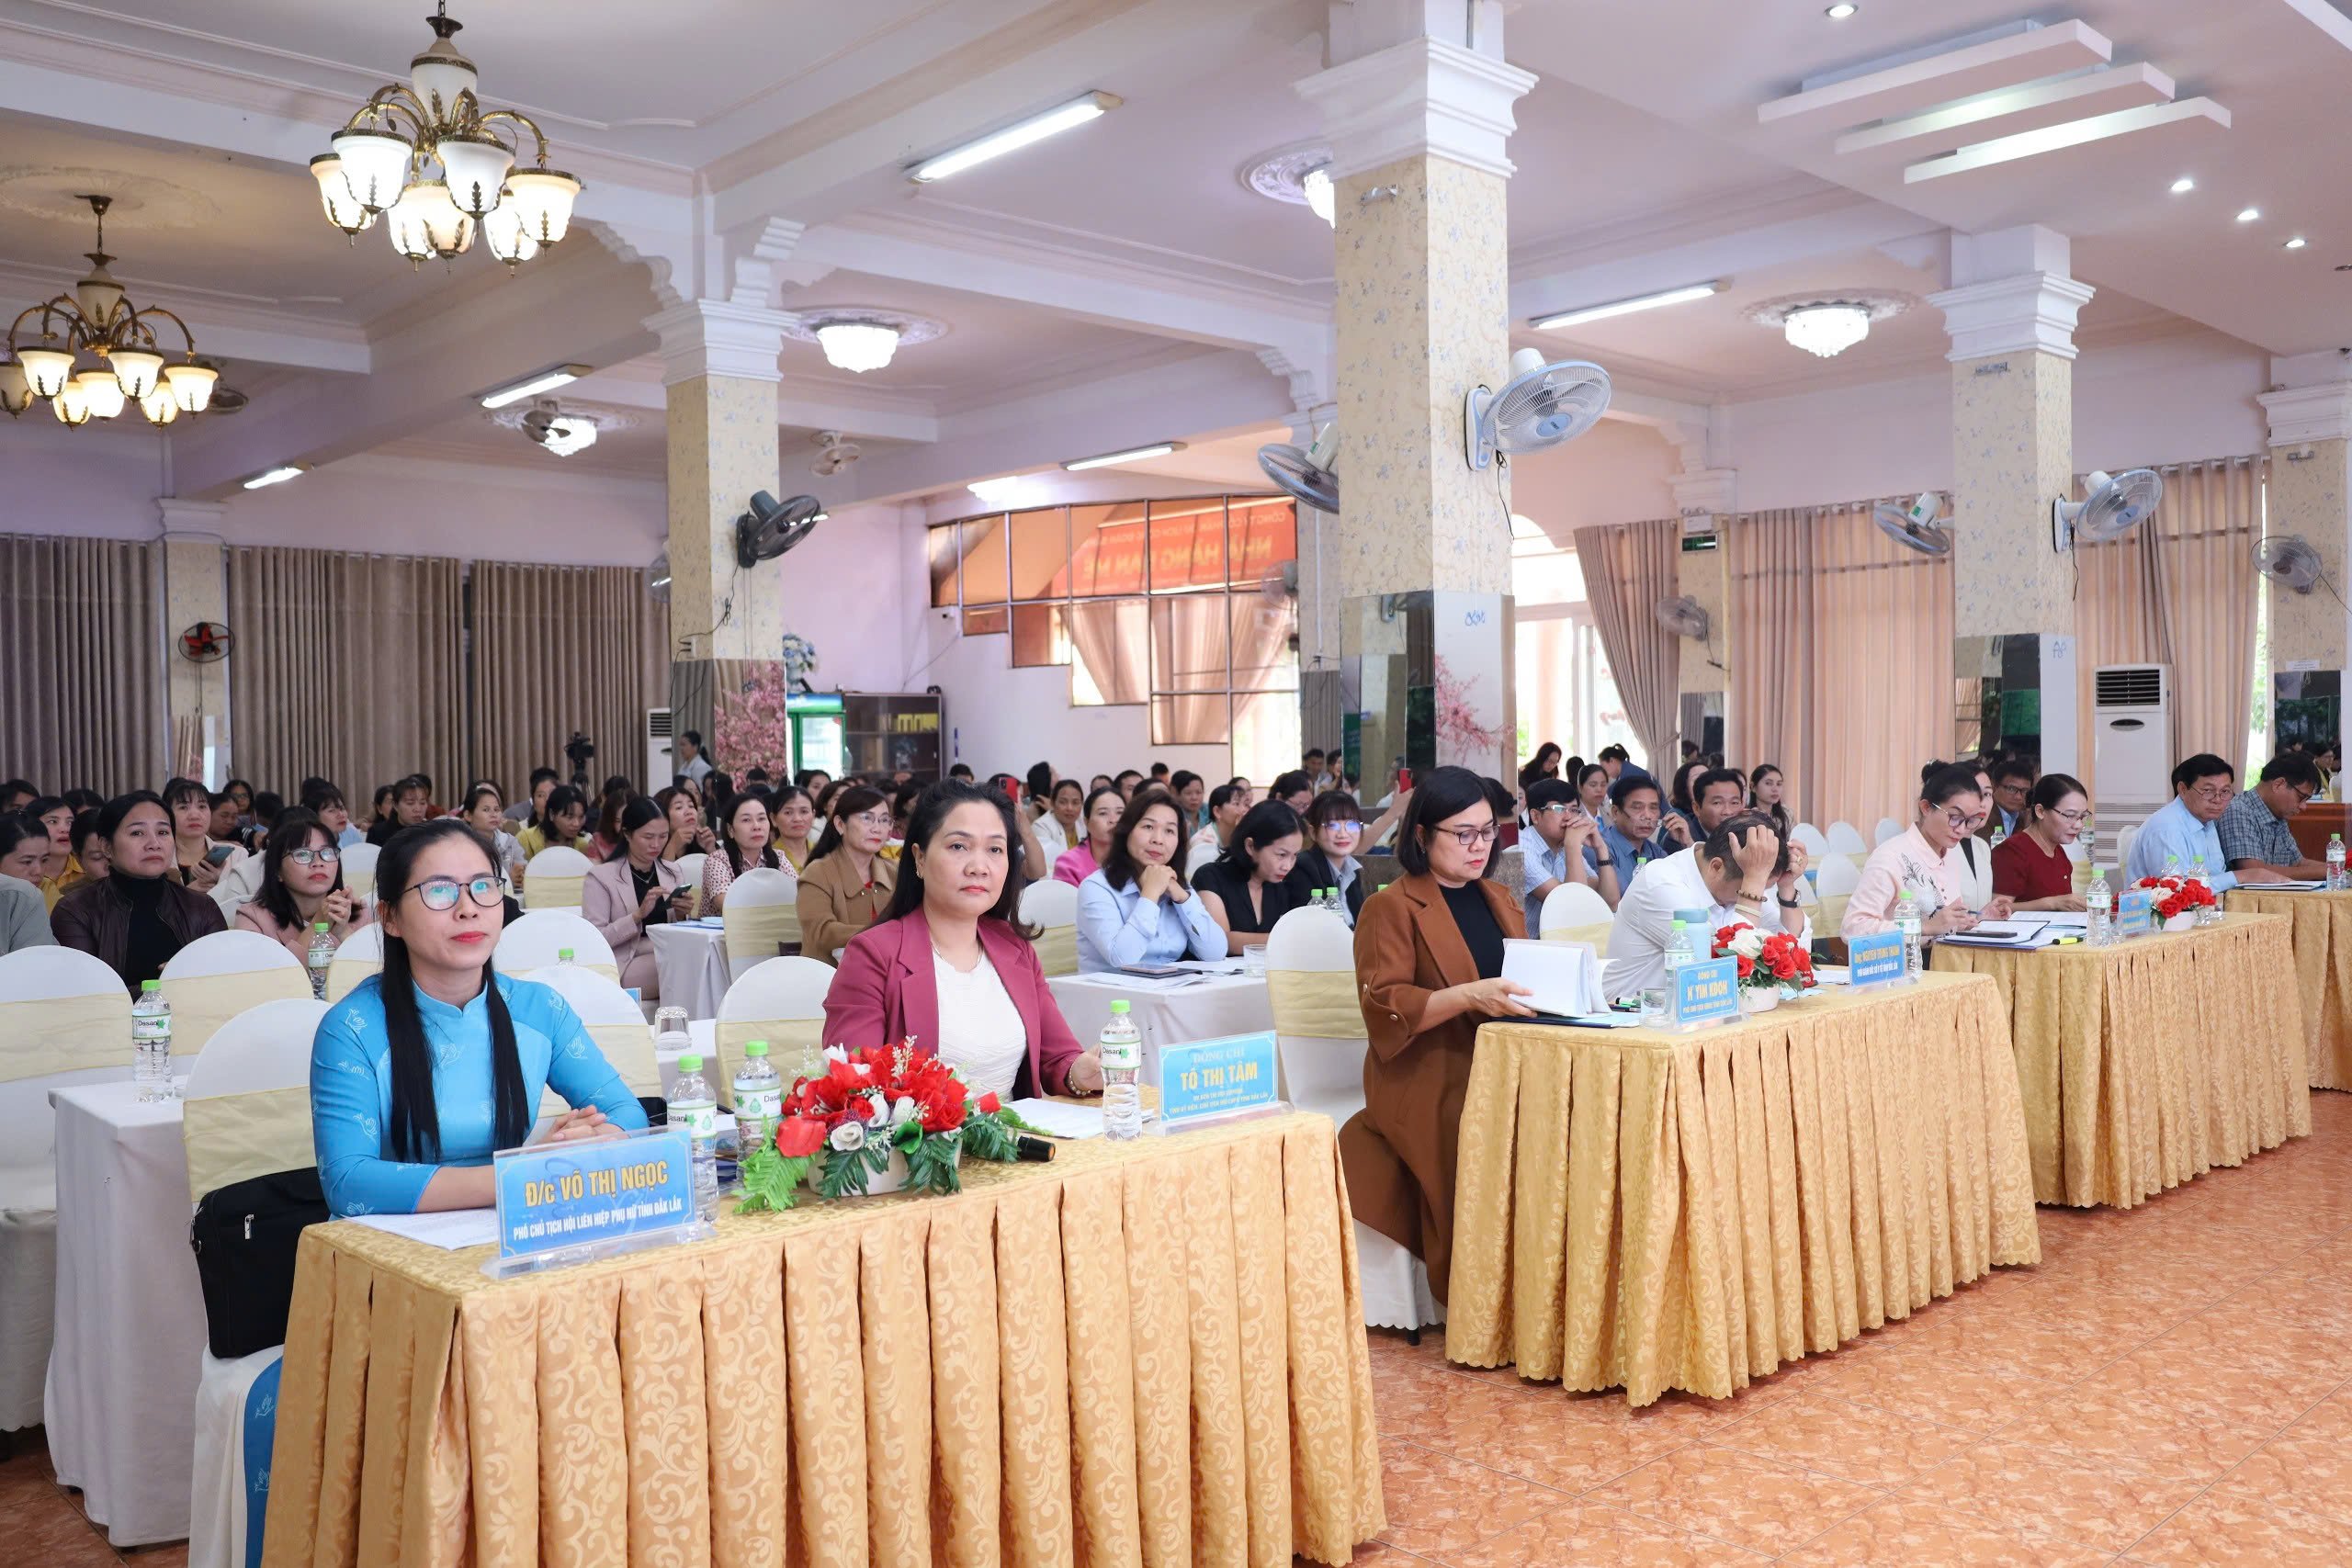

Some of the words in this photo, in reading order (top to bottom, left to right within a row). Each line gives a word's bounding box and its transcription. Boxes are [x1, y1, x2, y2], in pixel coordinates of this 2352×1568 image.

[1202, 1066, 1225, 1089] THỊ
[1227, 1059, 1258, 1084] TÂM
[525, 1179, 556, 1208] Đ/c
[560, 1168, 584, 1201] VÕ
[588, 1168, 616, 1198] THỊ
[620, 1160, 669, 1191] NGỌC
[513, 1223, 529, 1241] PHÓ
[529, 1219, 545, 1238] CHỦ
[545, 1218, 562, 1237] TỊCH
[562, 1216, 576, 1234] HỘI
[577, 1212, 594, 1230] LIÊN
[594, 1208, 610, 1227] HIỆP
[610, 1208, 626, 1224] PHỤ
[626, 1203, 638, 1221] NỮ
[637, 1201, 653, 1219] TỈNH
[653, 1197, 669, 1216] ĐẮK
[669, 1193, 683, 1213] LẮK
